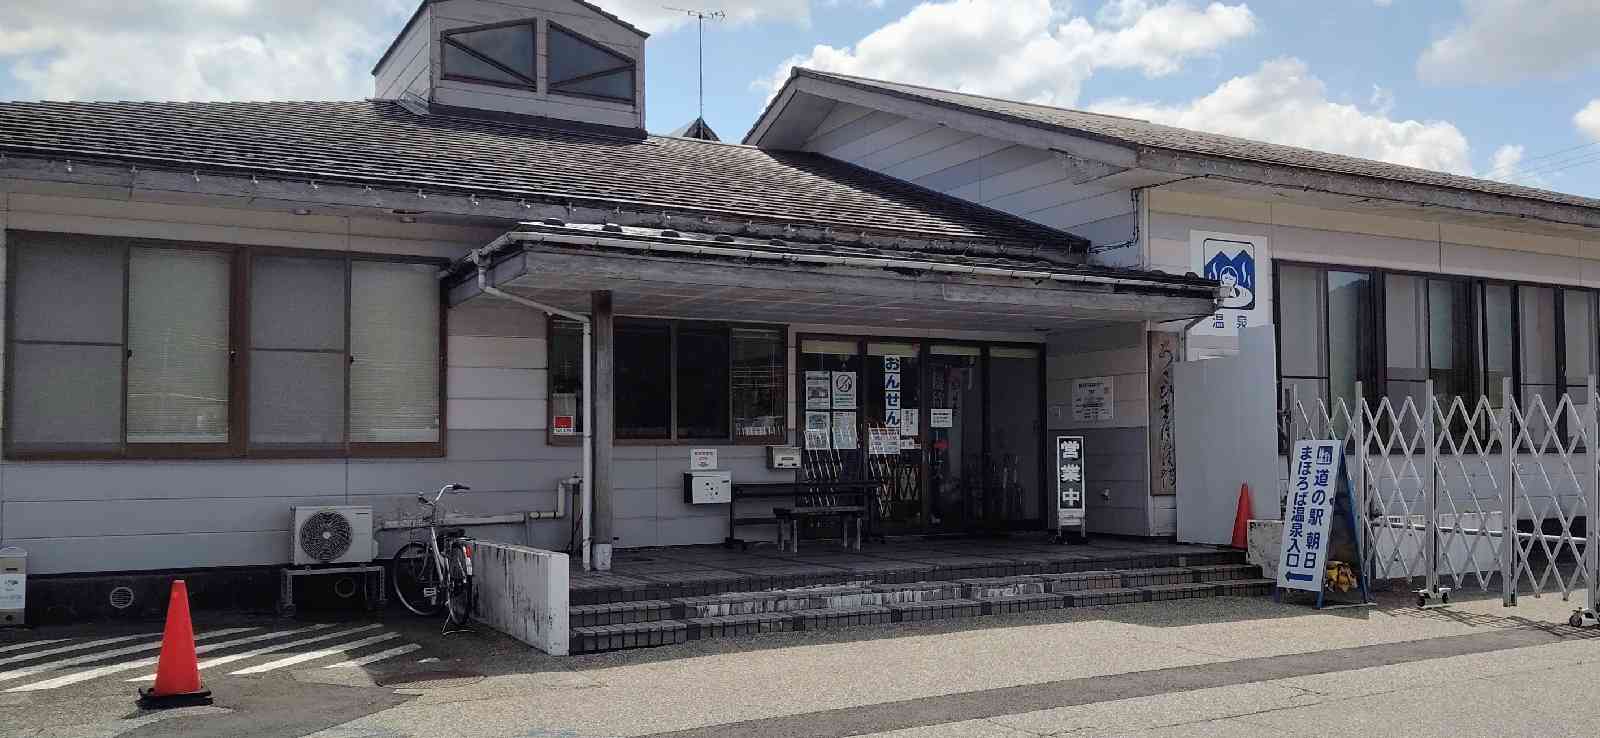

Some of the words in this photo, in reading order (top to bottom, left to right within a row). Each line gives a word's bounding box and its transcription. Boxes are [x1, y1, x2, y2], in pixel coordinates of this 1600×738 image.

[885, 357, 900, 426] おんせん
[1060, 441, 1081, 505] 営業中
[1286, 446, 1313, 568] まほろば温泉入口
